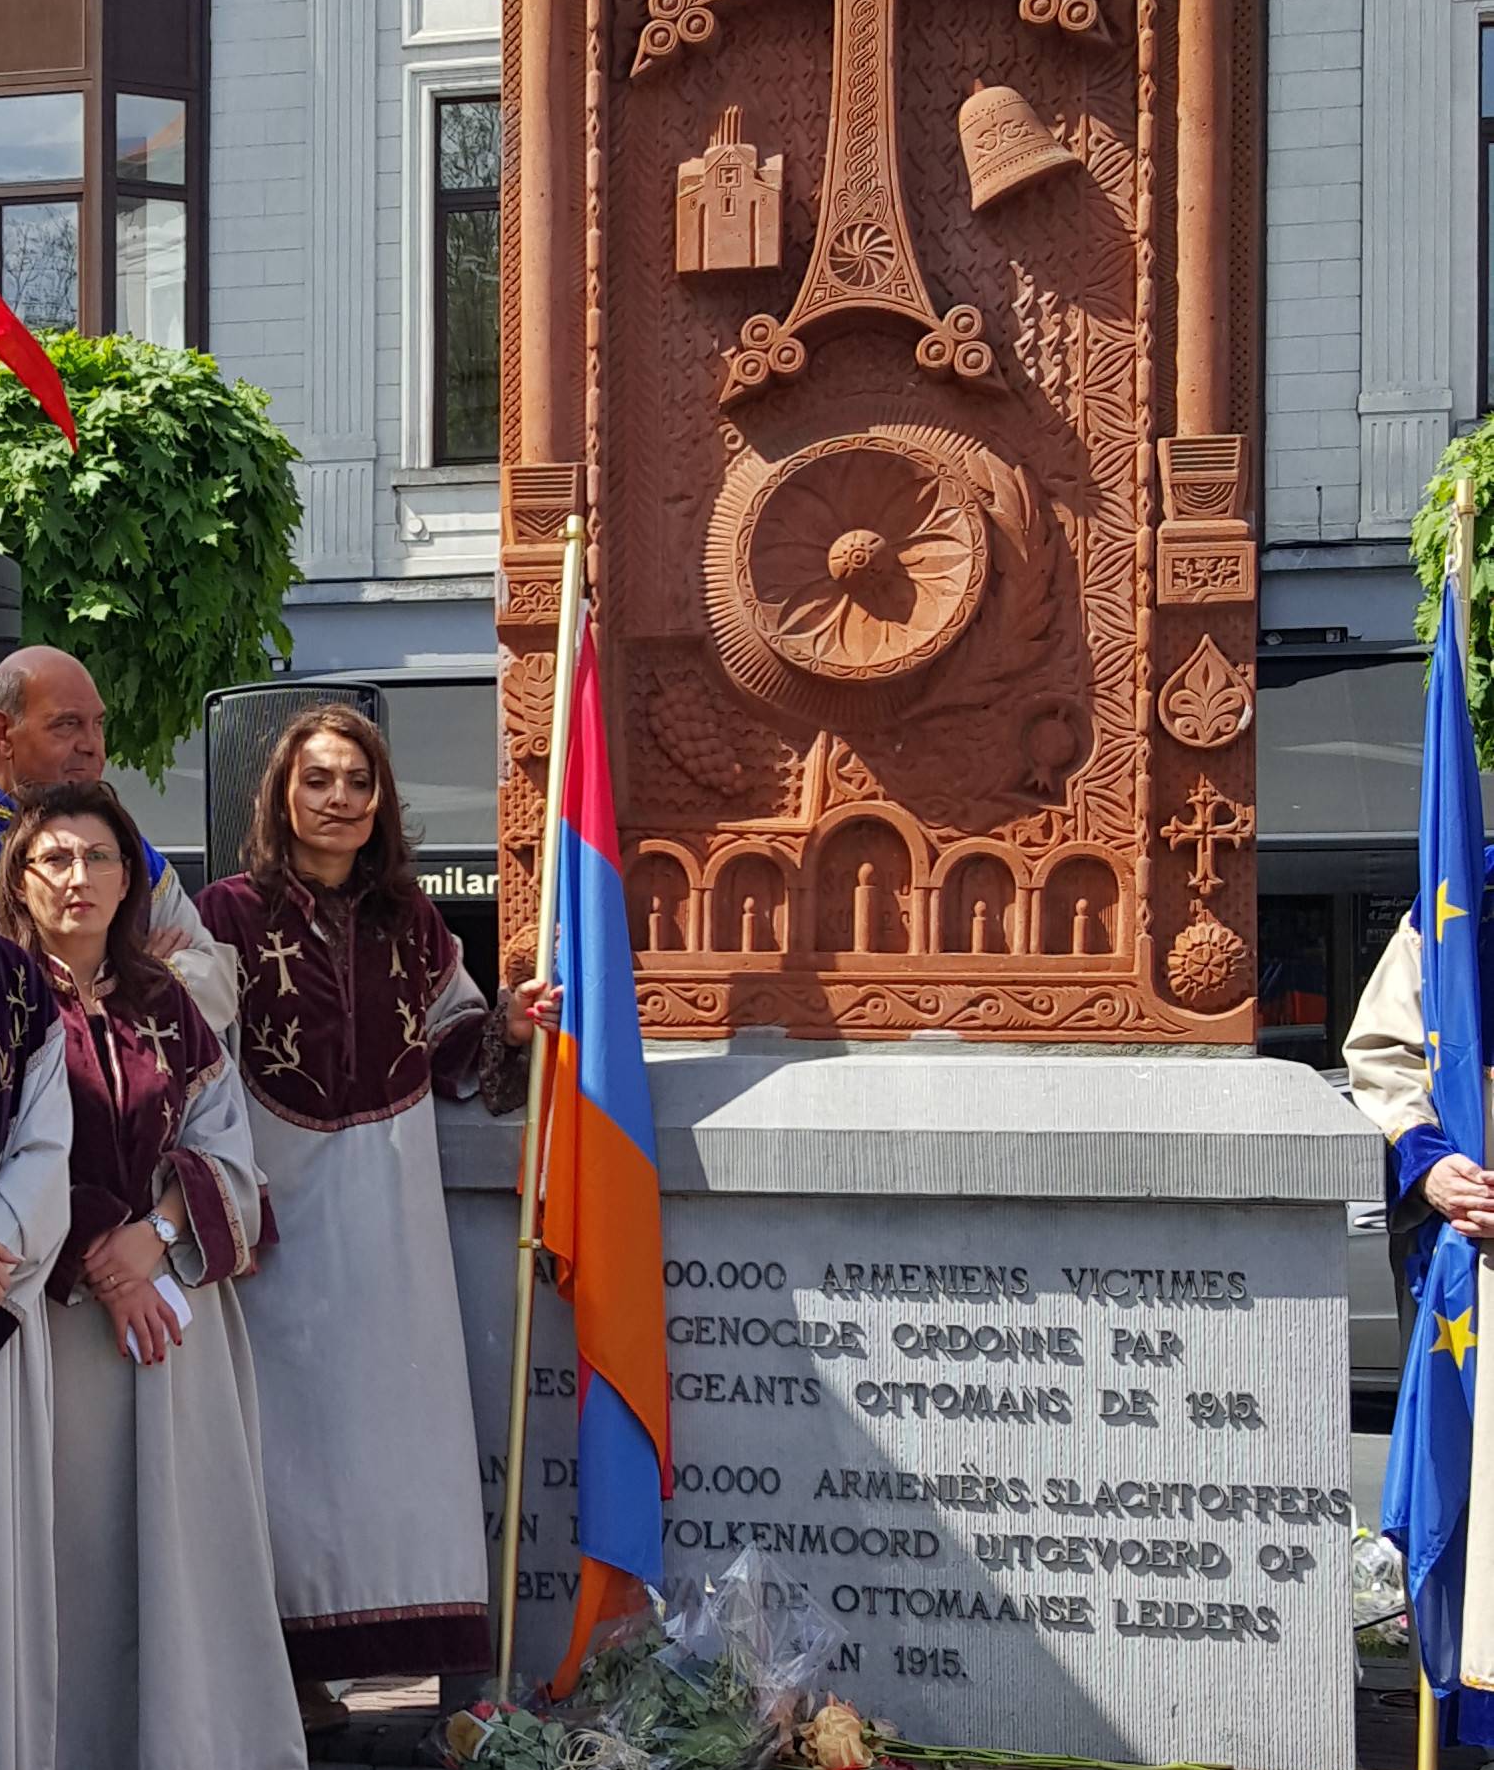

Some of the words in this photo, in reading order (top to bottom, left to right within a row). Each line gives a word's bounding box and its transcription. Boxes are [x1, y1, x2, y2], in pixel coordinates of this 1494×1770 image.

[663, 1260, 787, 1290] 00.000
[822, 1262, 1029, 1296] ARMENIENS
[1061, 1266, 1248, 1300] VICTIMES
[666, 1315, 860, 1350] GENOCIDE
[892, 1322, 1077, 1356] ORDONNE
[1111, 1327, 1182, 1360] PAR
[528, 1367, 576, 1397] ES
[668, 1371, 822, 1406] IGEANTS
[854, 1379, 1067, 1414] OTTOMANS
[1099, 1388, 1152, 1418] DE
[1042, 1477, 1350, 1514] SLACHTOFFERS
[973, 1533, 1224, 1569] UITGEVOERD
[1257, 1544, 1308, 1573] OP
[518, 1571, 578, 1601] BEV
[832, 1584, 1086, 1623] OTTOMAANSE
[1112, 1597, 1276, 1632] LEIDERS
[894, 1644, 967, 1679] 1915.
